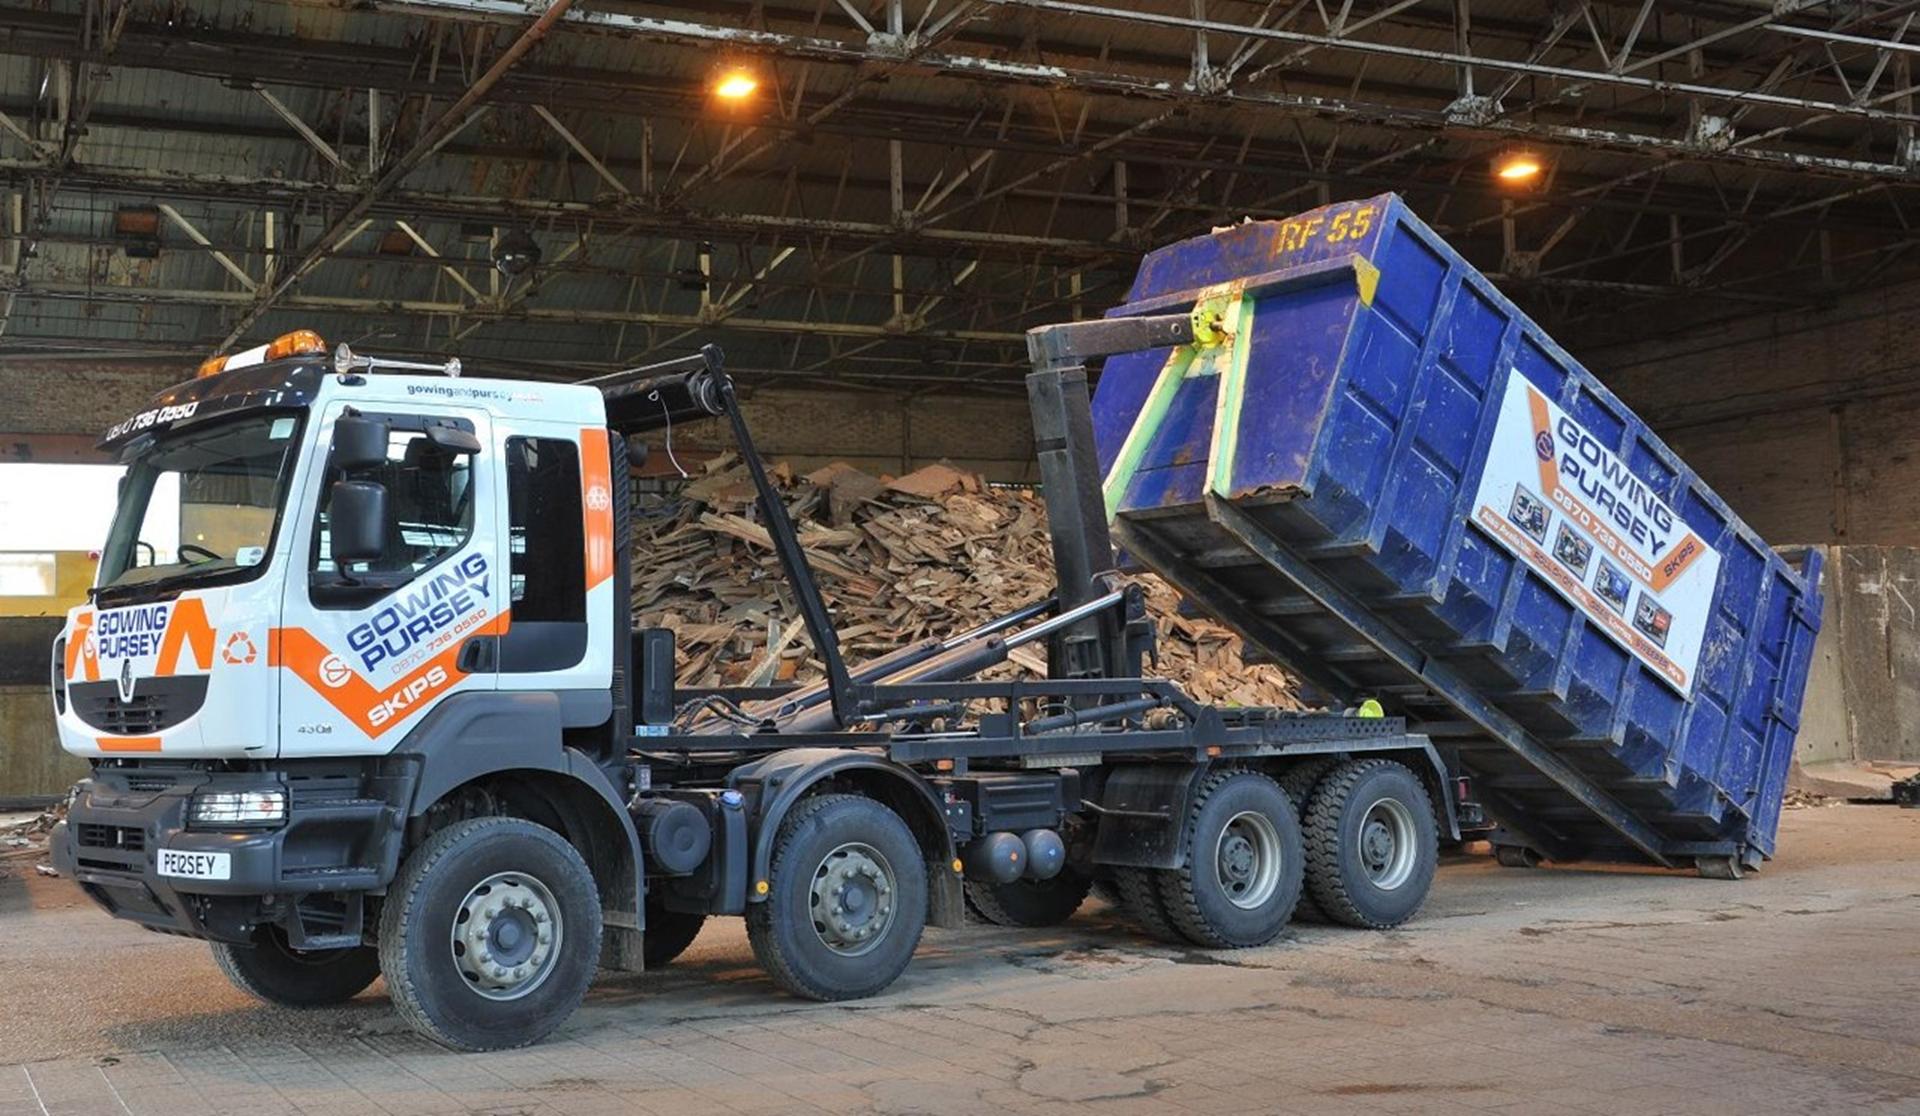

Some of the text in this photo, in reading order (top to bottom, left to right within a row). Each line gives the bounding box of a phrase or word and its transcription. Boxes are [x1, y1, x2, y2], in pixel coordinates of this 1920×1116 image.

[1327, 205, 1374, 242] 55
[1557, 416, 1673, 534] GOWING
[1553, 487, 1591, 526] 0870
[1560, 453, 1666, 556] PURSEY
[1663, 541, 1696, 577] SKIPS
[98, 606, 168, 637] GOWING
[347, 552, 487, 651] GOWING
[360, 573, 491, 673] PURSEY
[99, 632, 162, 660] PURSEY
[391, 609, 487, 675] 0870 736 0550
[367, 665, 448, 728] SKIPS
[164, 853, 216, 875] PE12SEY
